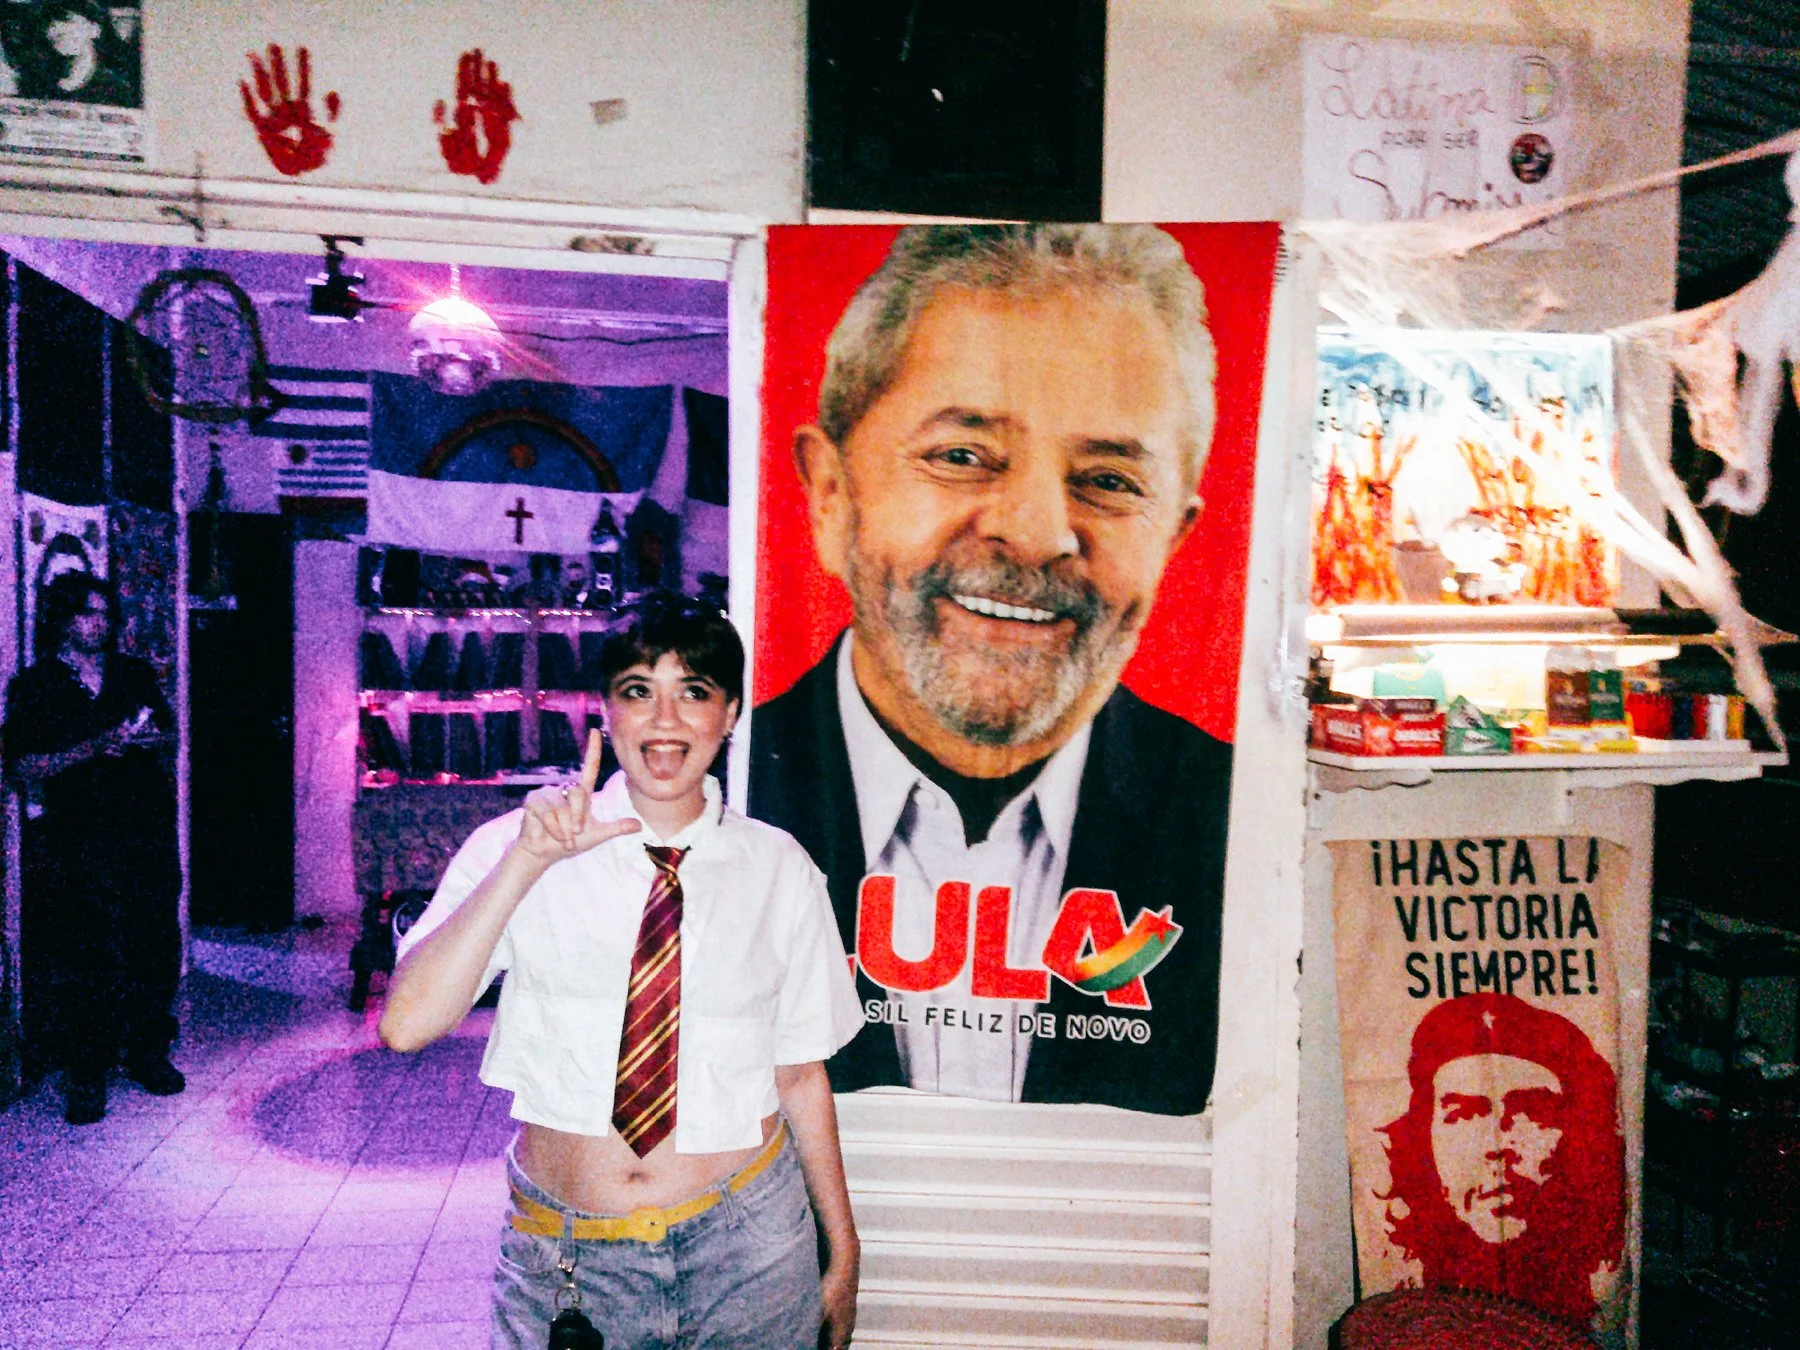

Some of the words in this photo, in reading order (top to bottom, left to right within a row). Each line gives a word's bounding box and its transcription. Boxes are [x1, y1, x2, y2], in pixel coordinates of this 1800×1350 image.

[1369, 838, 1537, 887] ¡HASTA
[846, 872, 1153, 1011] ULA
[1394, 892, 1599, 942] VICTORIA
[1405, 949, 1599, 999] SIEMPRE!
[866, 1001, 909, 1023] SIL
[925, 1006, 1004, 1034] FELIZ
[1018, 1013, 1055, 1038] DE
[1067, 1014, 1152, 1044] NOVO
